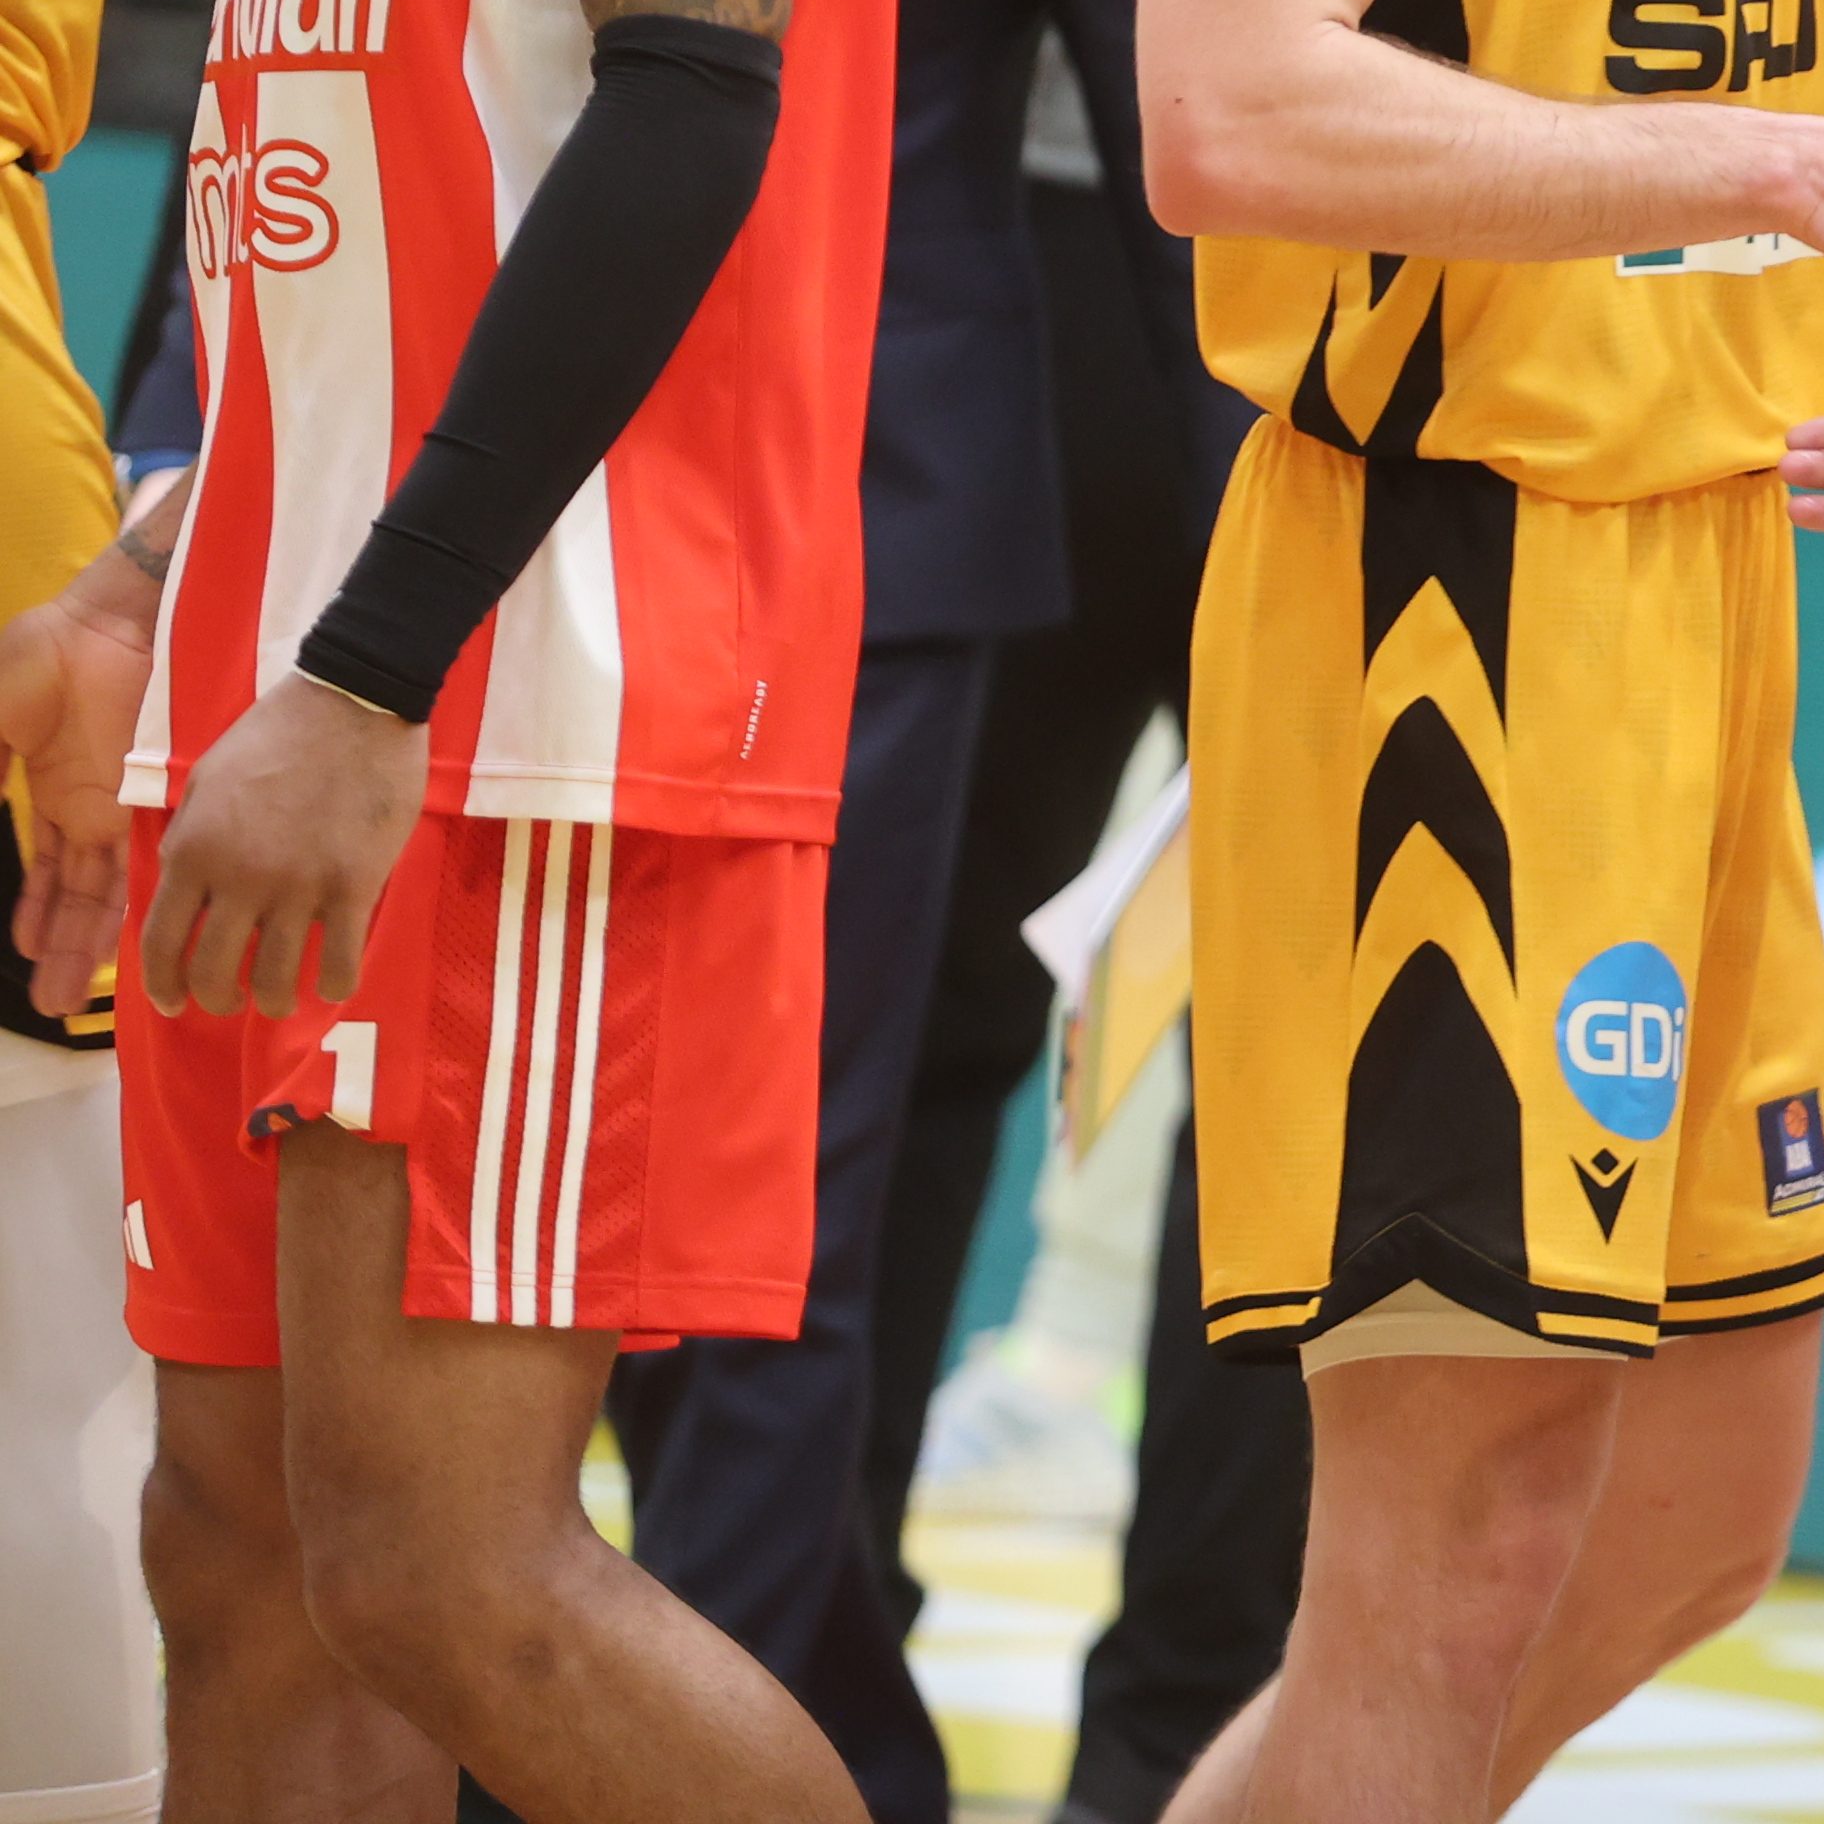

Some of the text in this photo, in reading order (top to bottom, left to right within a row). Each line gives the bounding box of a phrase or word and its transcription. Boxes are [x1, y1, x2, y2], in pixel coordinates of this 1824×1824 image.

[187, 124, 340, 280] mts
[320, 1020, 378, 1131] 1
[1565, 999, 1686, 1082] GDi
